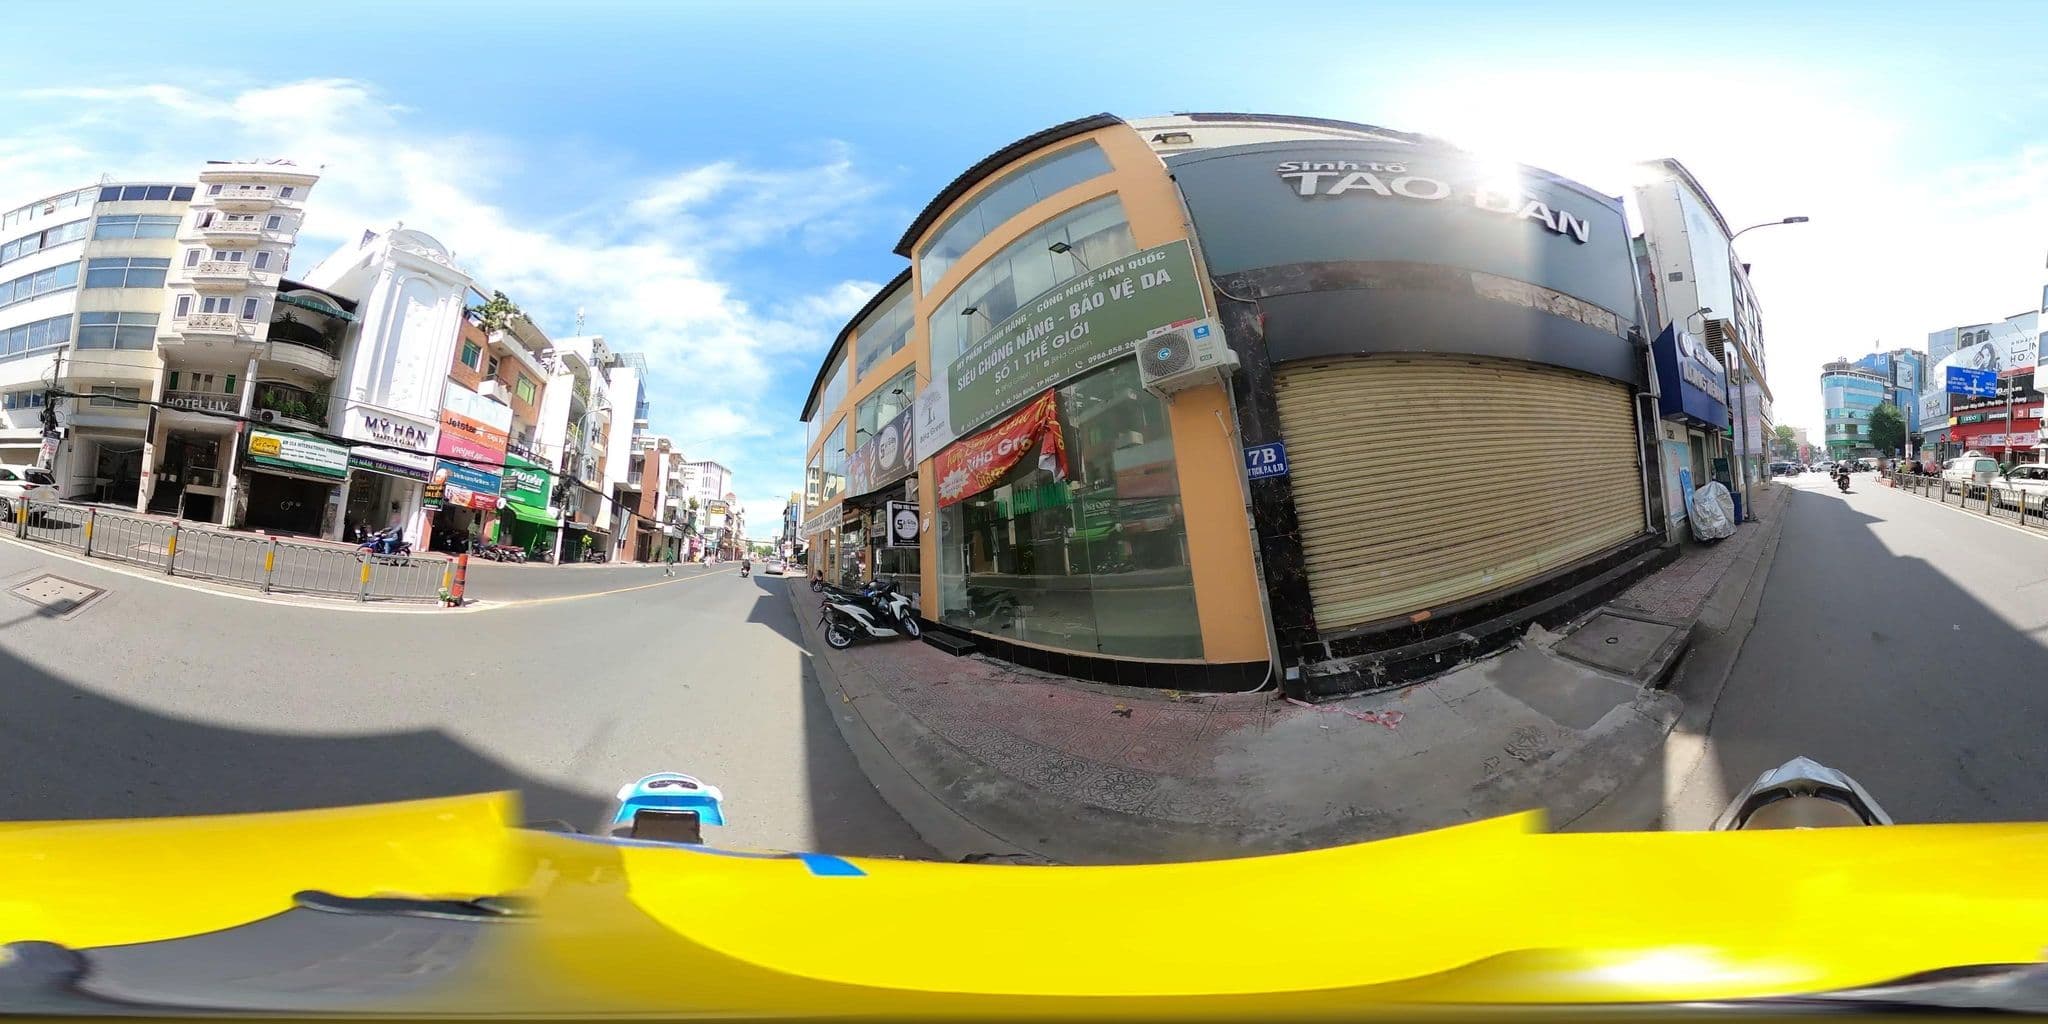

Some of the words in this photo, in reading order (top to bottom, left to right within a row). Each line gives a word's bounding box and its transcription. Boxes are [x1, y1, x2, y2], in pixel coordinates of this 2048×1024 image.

[1276, 160, 1358, 173] Sinh
[1281, 171, 1451, 200] TAO
[957, 366, 976, 391] SIÊU
[1069, 292, 1105, 320] BẢO
[1109, 277, 1135, 301] VỆ
[1140, 268, 1172, 290] DA
[995, 359, 1010, 384] SỐ
[1023, 335, 1049, 365] THẾ
[1052, 321, 1090, 349] GIỚI
[1874, 354, 1886, 367] ila
[166, 396, 206, 410] HOTEL
[208, 400, 229, 412] LIV
[365, 415, 389, 433] MỸ
[447, 417, 477, 434] Jetstar
[1248, 447, 1277, 466] 7B
